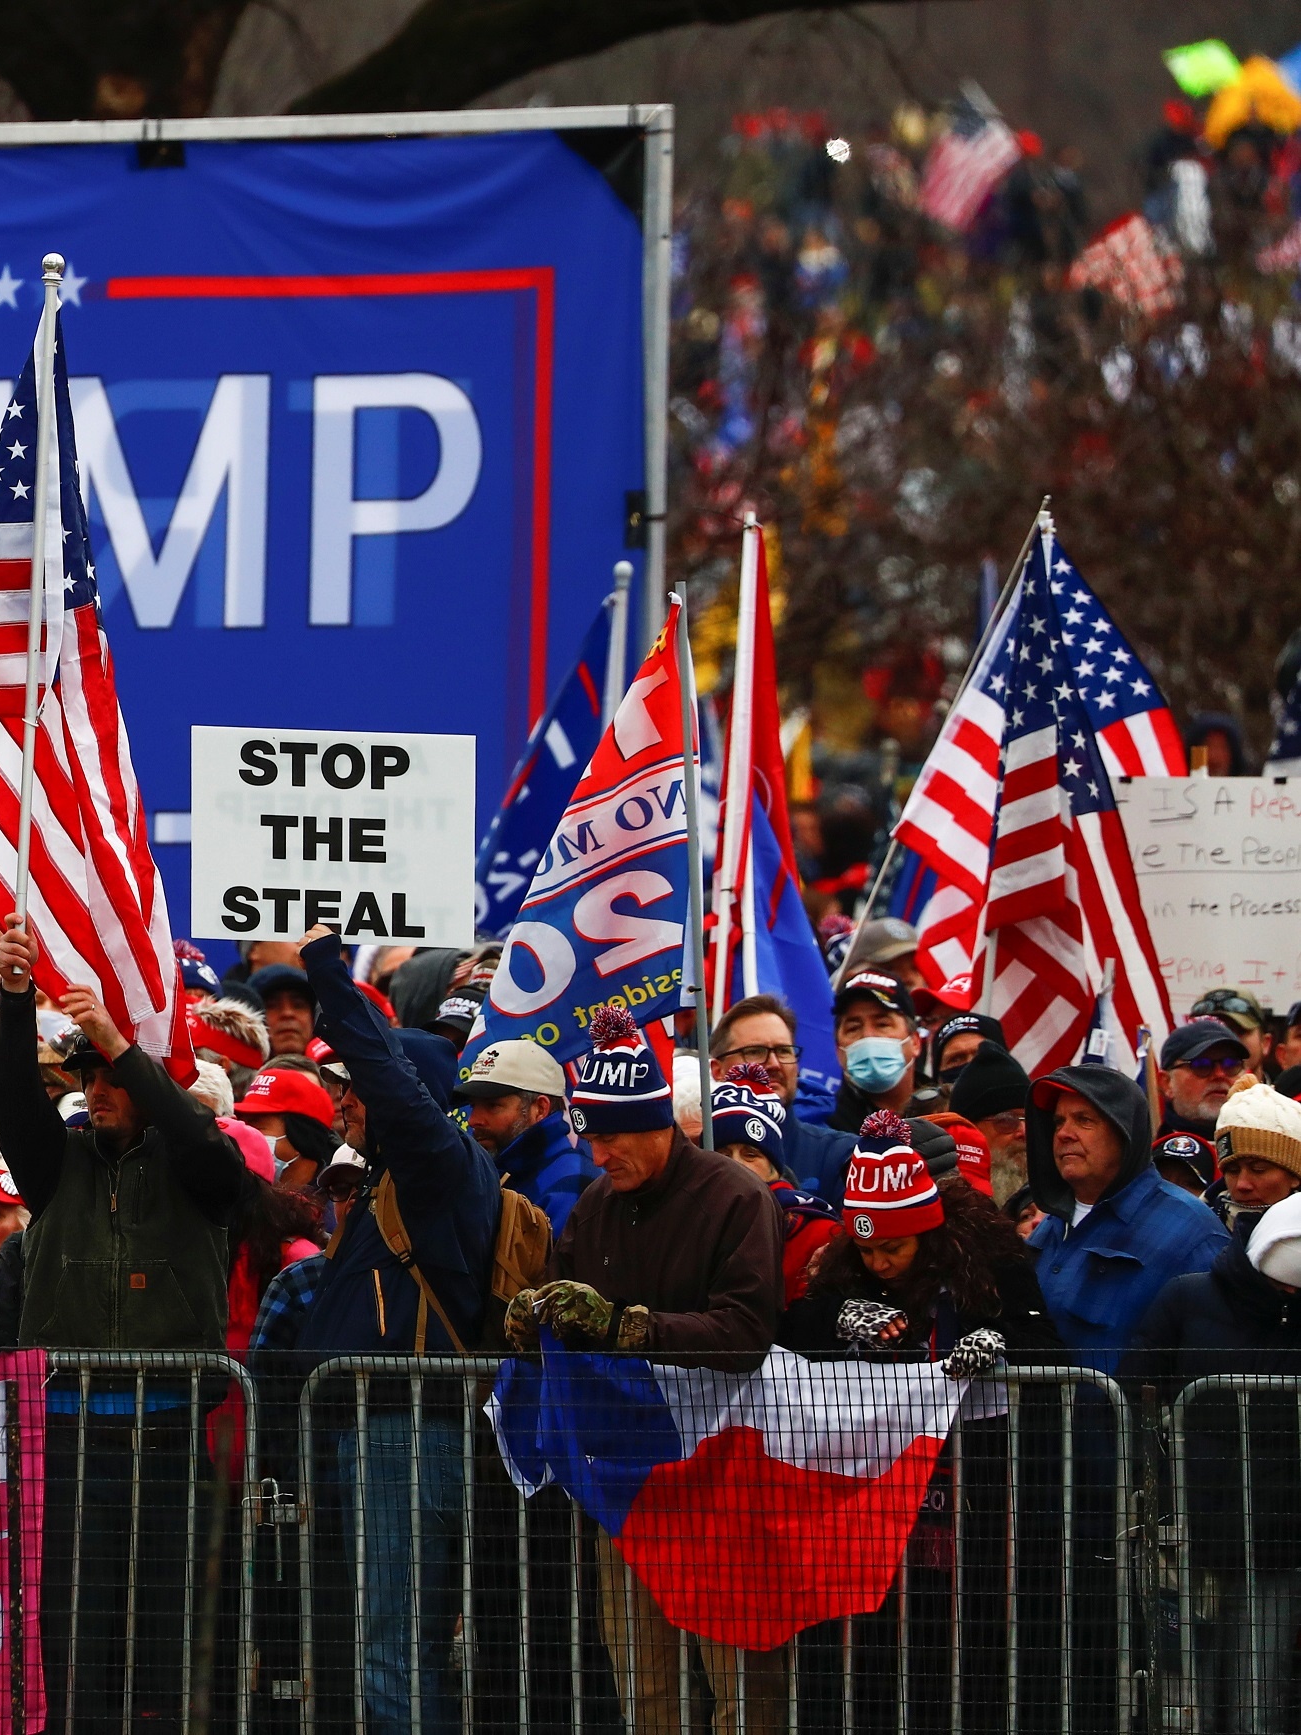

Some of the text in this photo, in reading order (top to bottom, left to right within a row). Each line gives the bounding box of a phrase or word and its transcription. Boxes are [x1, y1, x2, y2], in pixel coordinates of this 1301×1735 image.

[238, 739, 410, 790] STOP
[1213, 786, 1235, 815] A
[260, 814, 387, 863] THE
[1177, 842, 1231, 864] The
[221, 885, 426, 938] STEAL
[1158, 957, 1227, 984] eping
[581, 1059, 649, 1088] UMP
[573, 1112, 585, 1126] 45
[749, 1122, 764, 1138] 45
[846, 1160, 925, 1193] RUMP
[856, 1219, 871, 1233] 45
